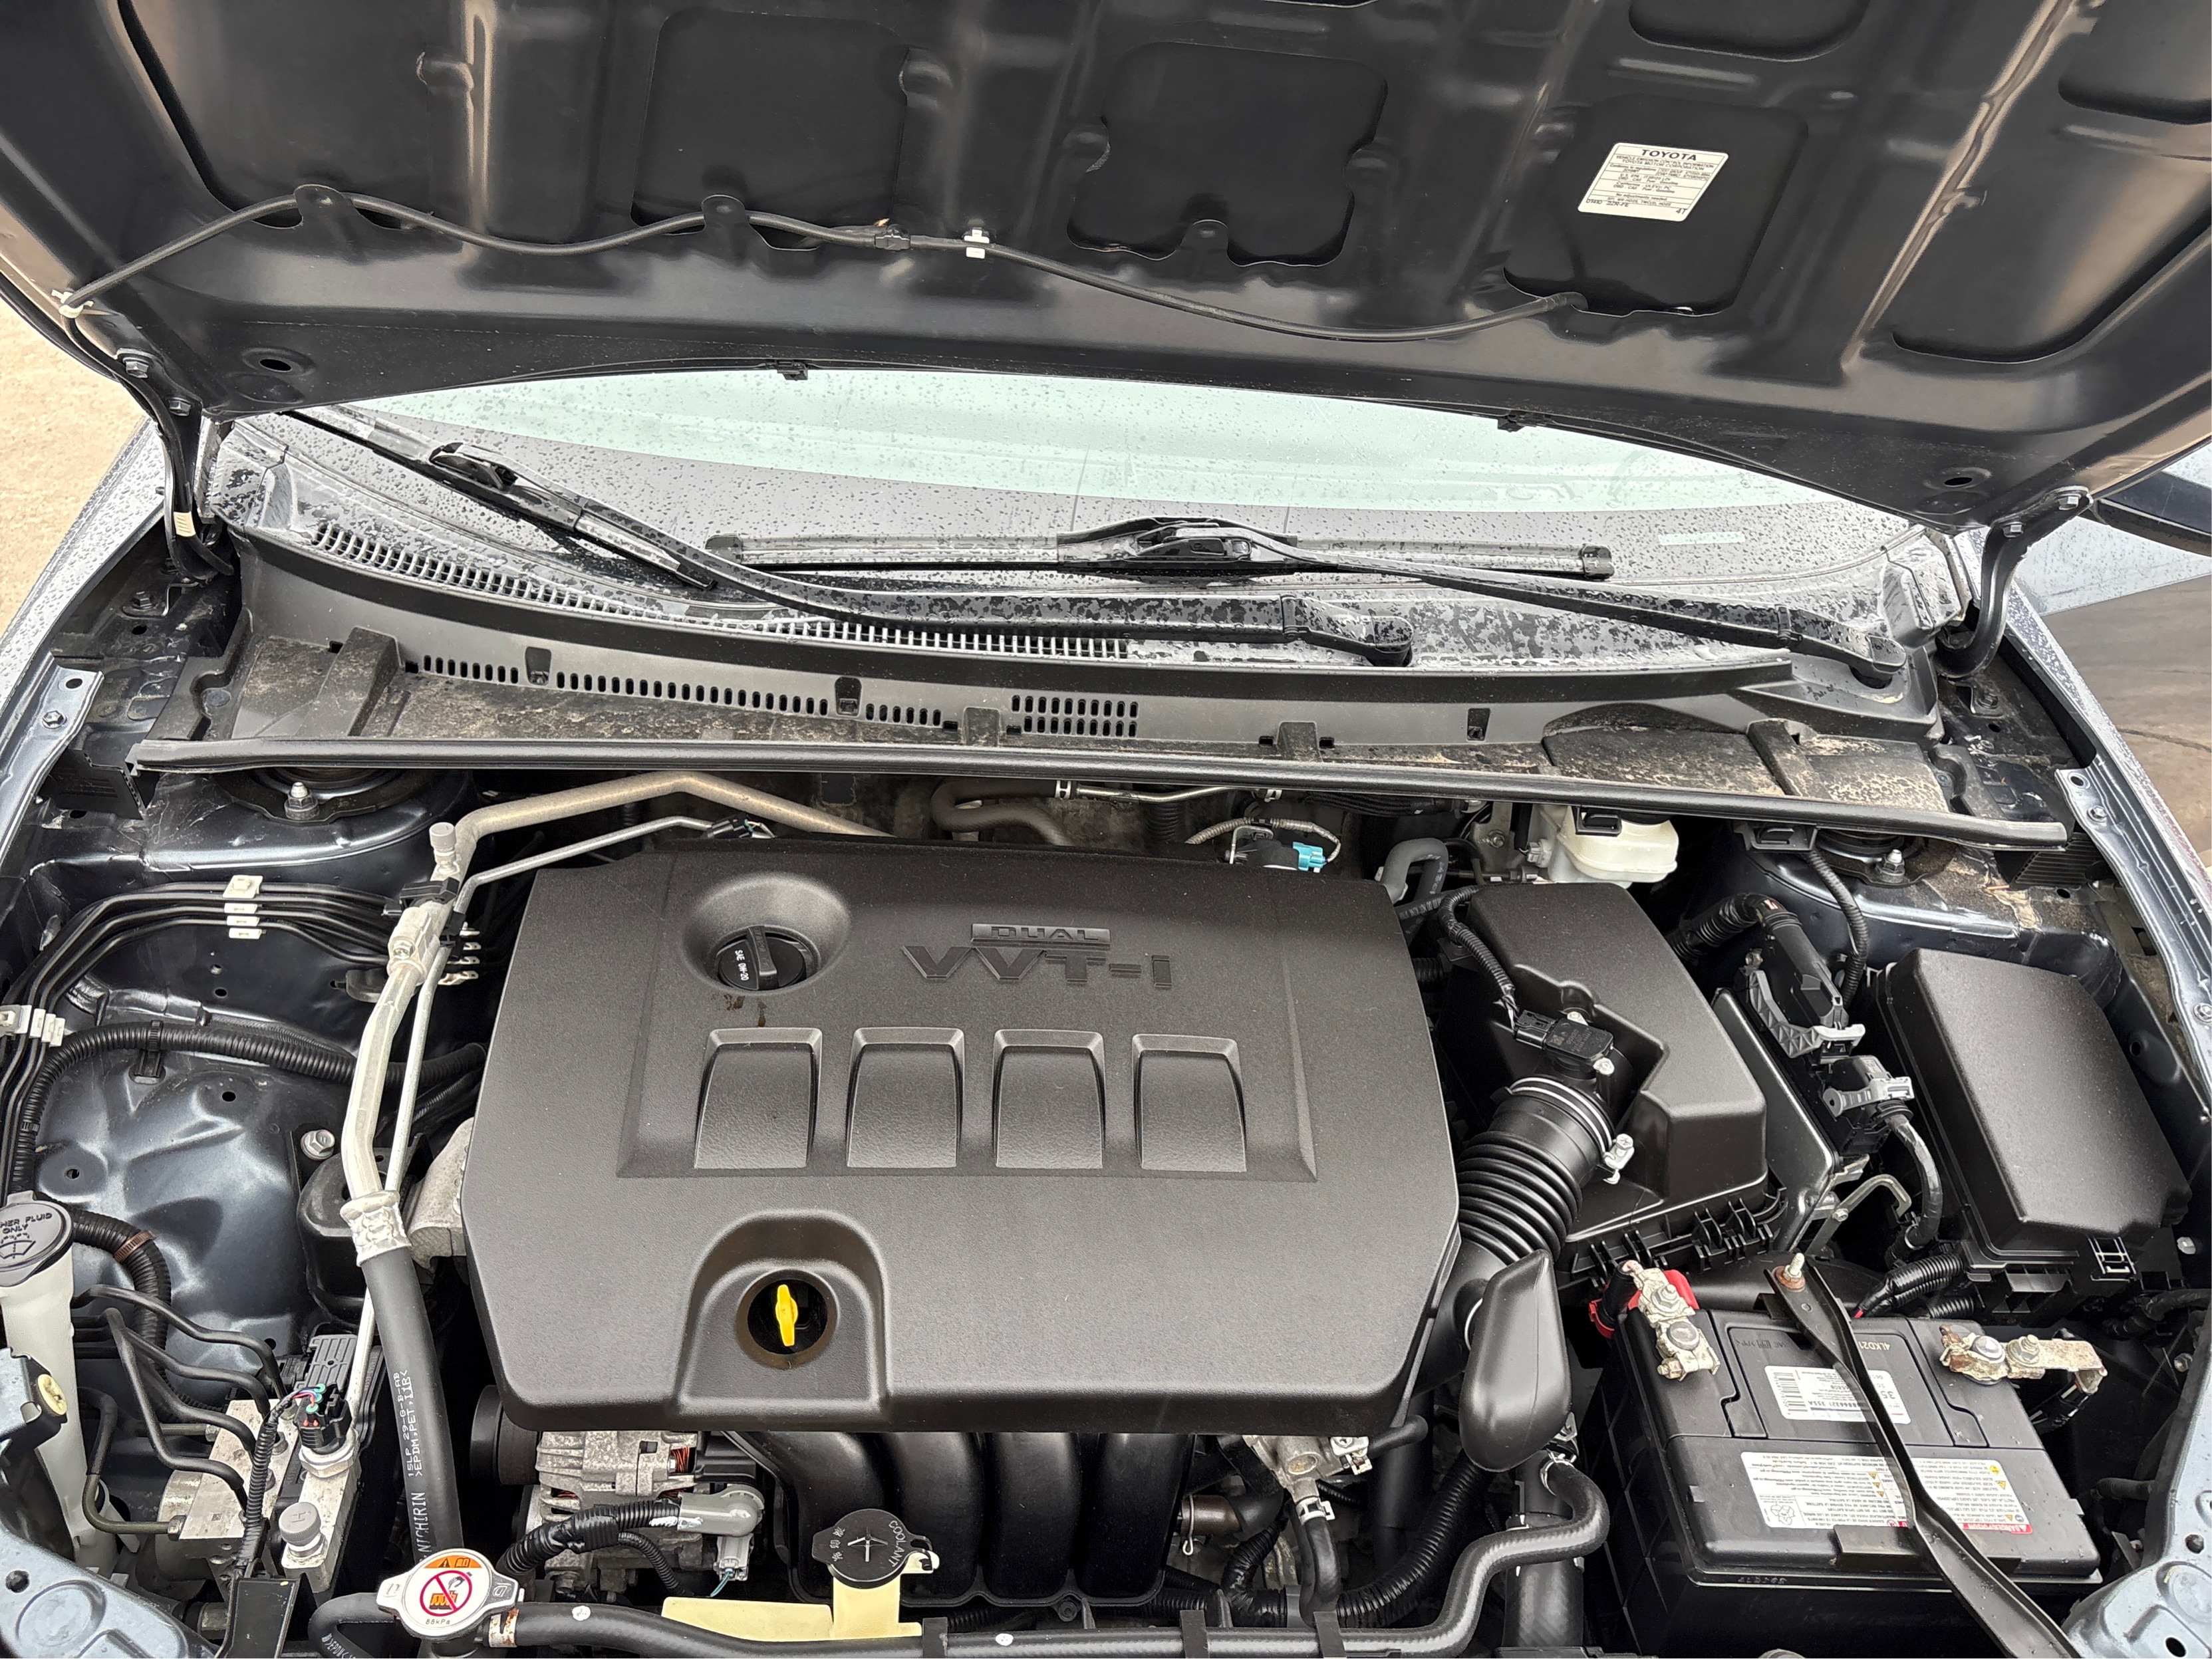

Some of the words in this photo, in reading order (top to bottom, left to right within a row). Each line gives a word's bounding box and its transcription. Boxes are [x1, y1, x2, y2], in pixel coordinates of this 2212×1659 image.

[1639, 149, 1699, 160] TOYOTA
[991, 926, 1099, 940] DUAL
[734, 950, 746, 961] SAE
[738, 962, 750, 981] 0W-20
[25, 1212, 53, 1223] FLUID
[3, 1223, 29, 1233] ONLY
[410, 1491, 432, 1553] NICHIRIN
[889, 1520, 906, 1567] COOLANT
